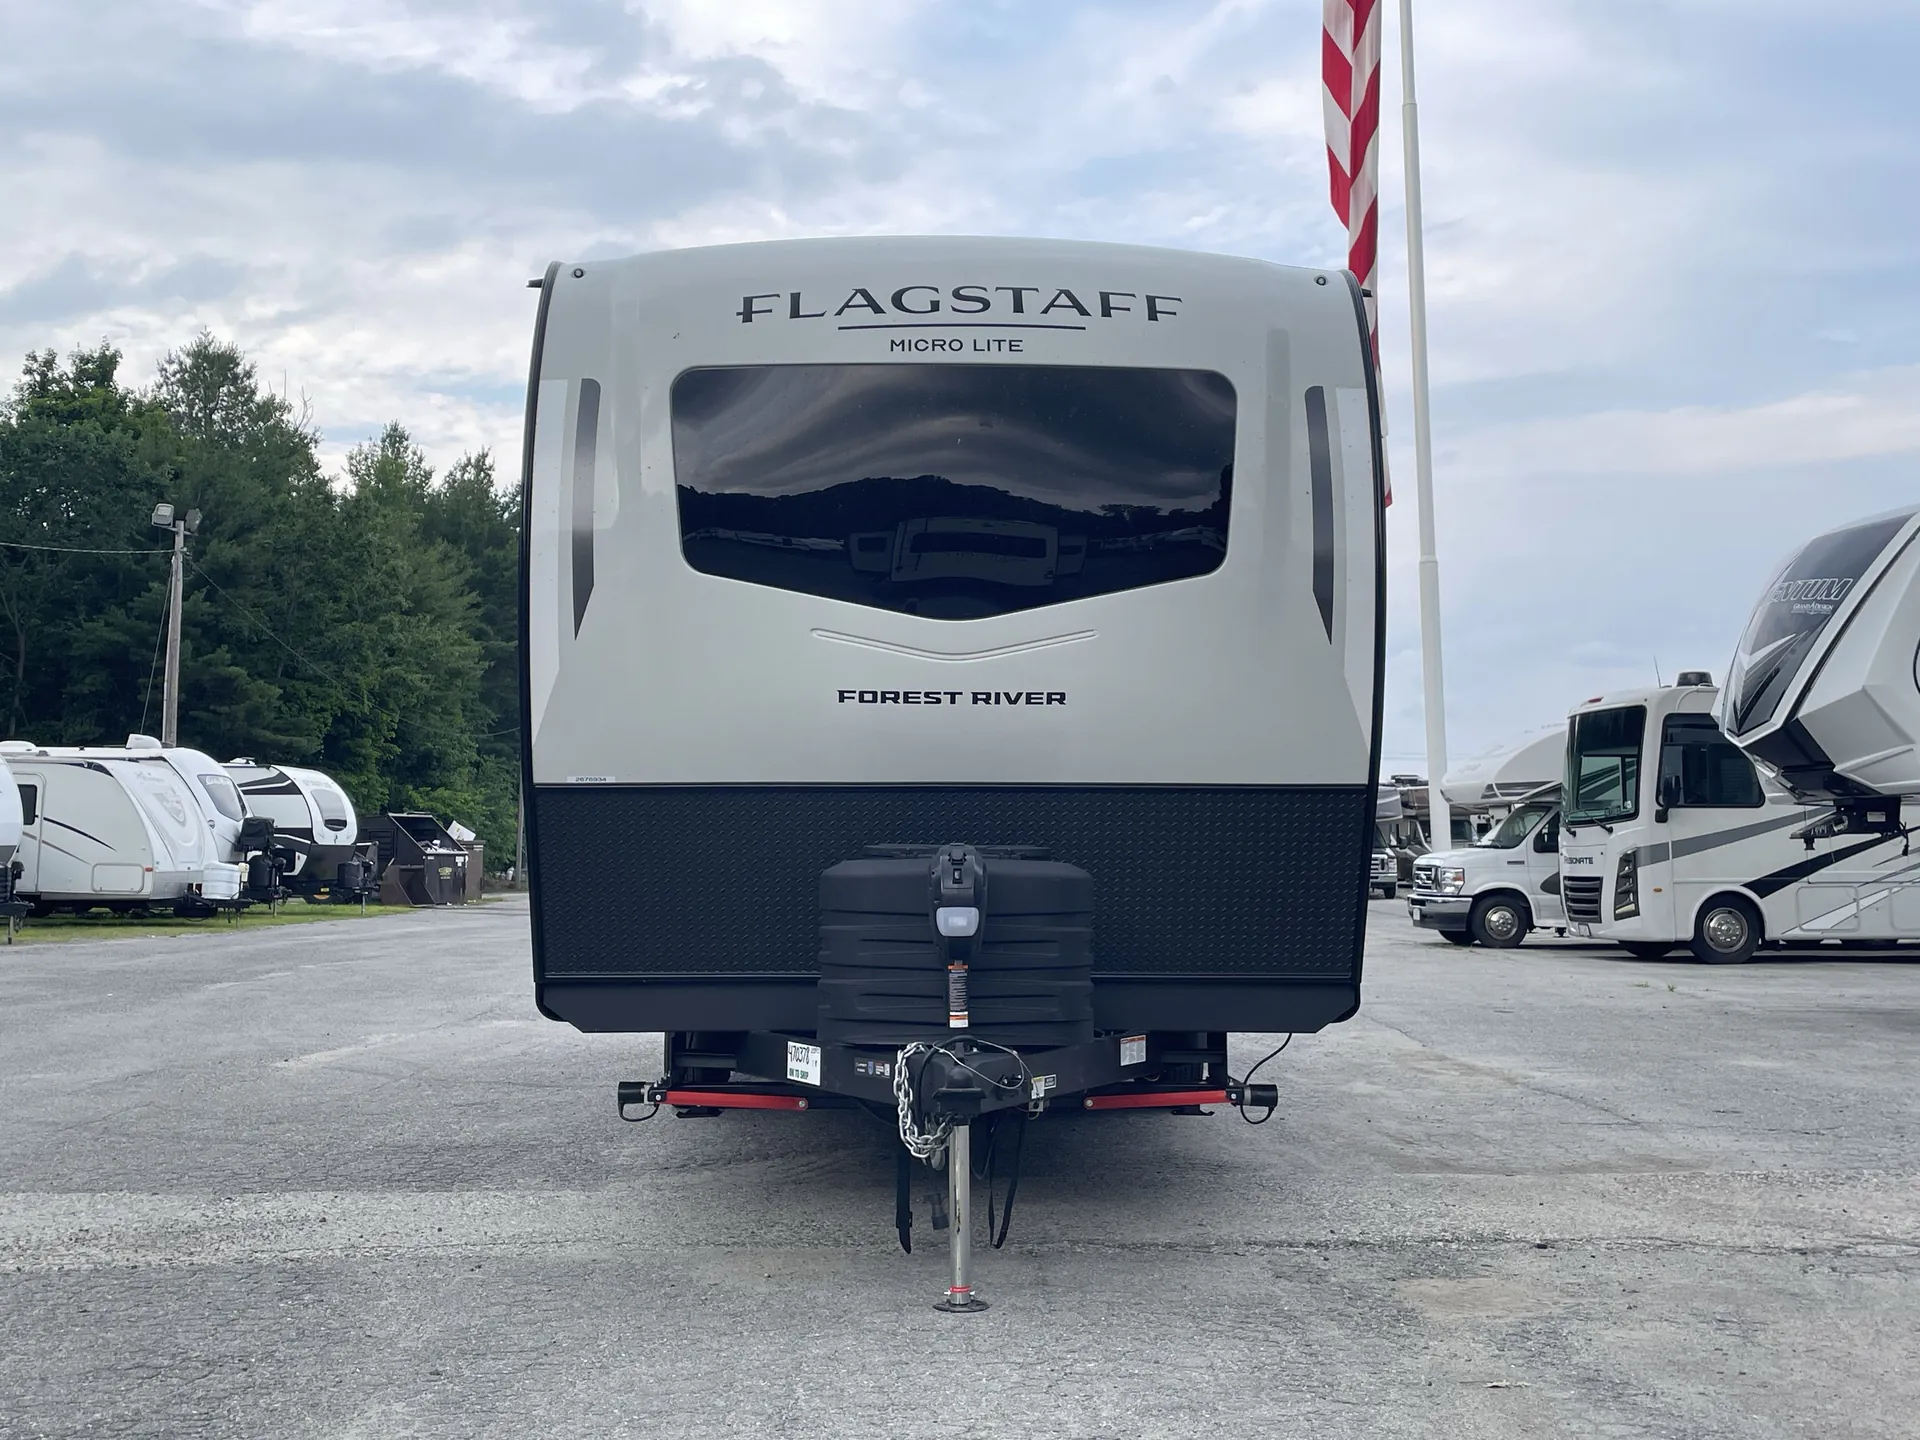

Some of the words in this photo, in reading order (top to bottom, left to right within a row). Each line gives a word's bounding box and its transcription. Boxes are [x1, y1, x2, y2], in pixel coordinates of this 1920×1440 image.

[735, 285, 1183, 323] FLAGSTAFF
[890, 338, 964, 352] MICRO
[973, 338, 1024, 353] LITE
[837, 689, 964, 705] FOREST
[970, 691, 1067, 706] RIVER
